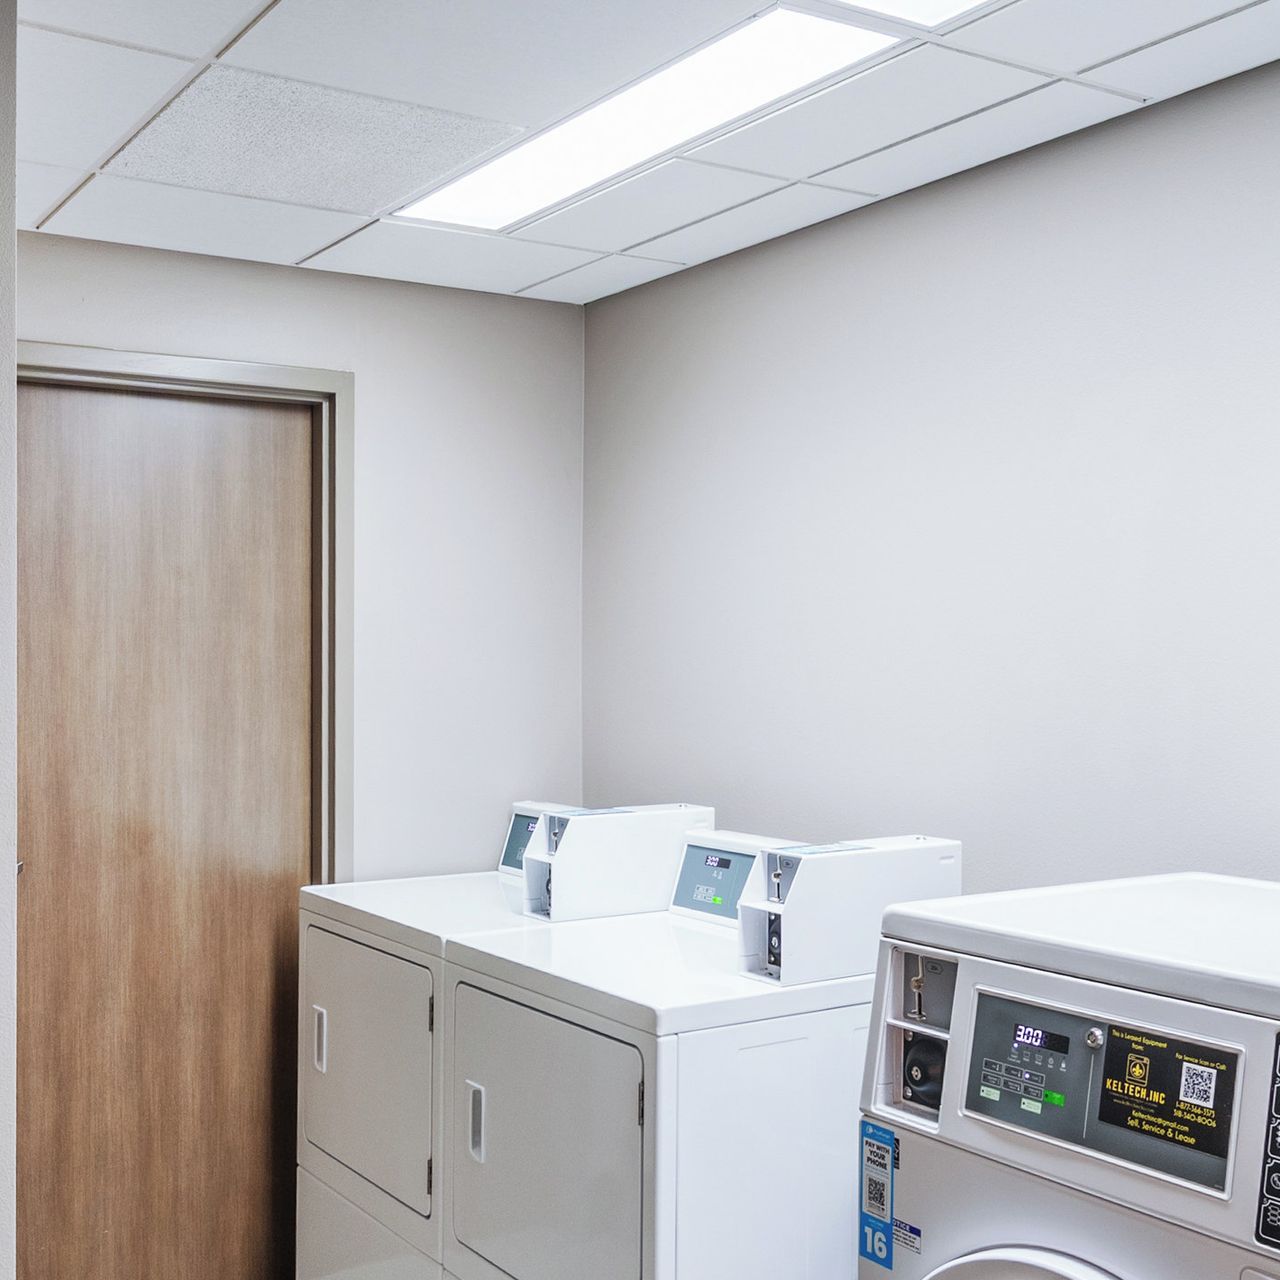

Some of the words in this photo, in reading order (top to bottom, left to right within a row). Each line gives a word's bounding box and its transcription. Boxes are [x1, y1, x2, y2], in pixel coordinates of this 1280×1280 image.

[1142, 1121, 1165, 1137] Service
[1167, 1129, 1173, 1139] &
[1175, 1131, 1196, 1145] Lease
[869, 1148, 886, 1161] YOUR
[866, 1156, 888, 1170] PHONE
[893, 1219, 911, 1232] OTICE
[864, 1225, 887, 1259] 16
